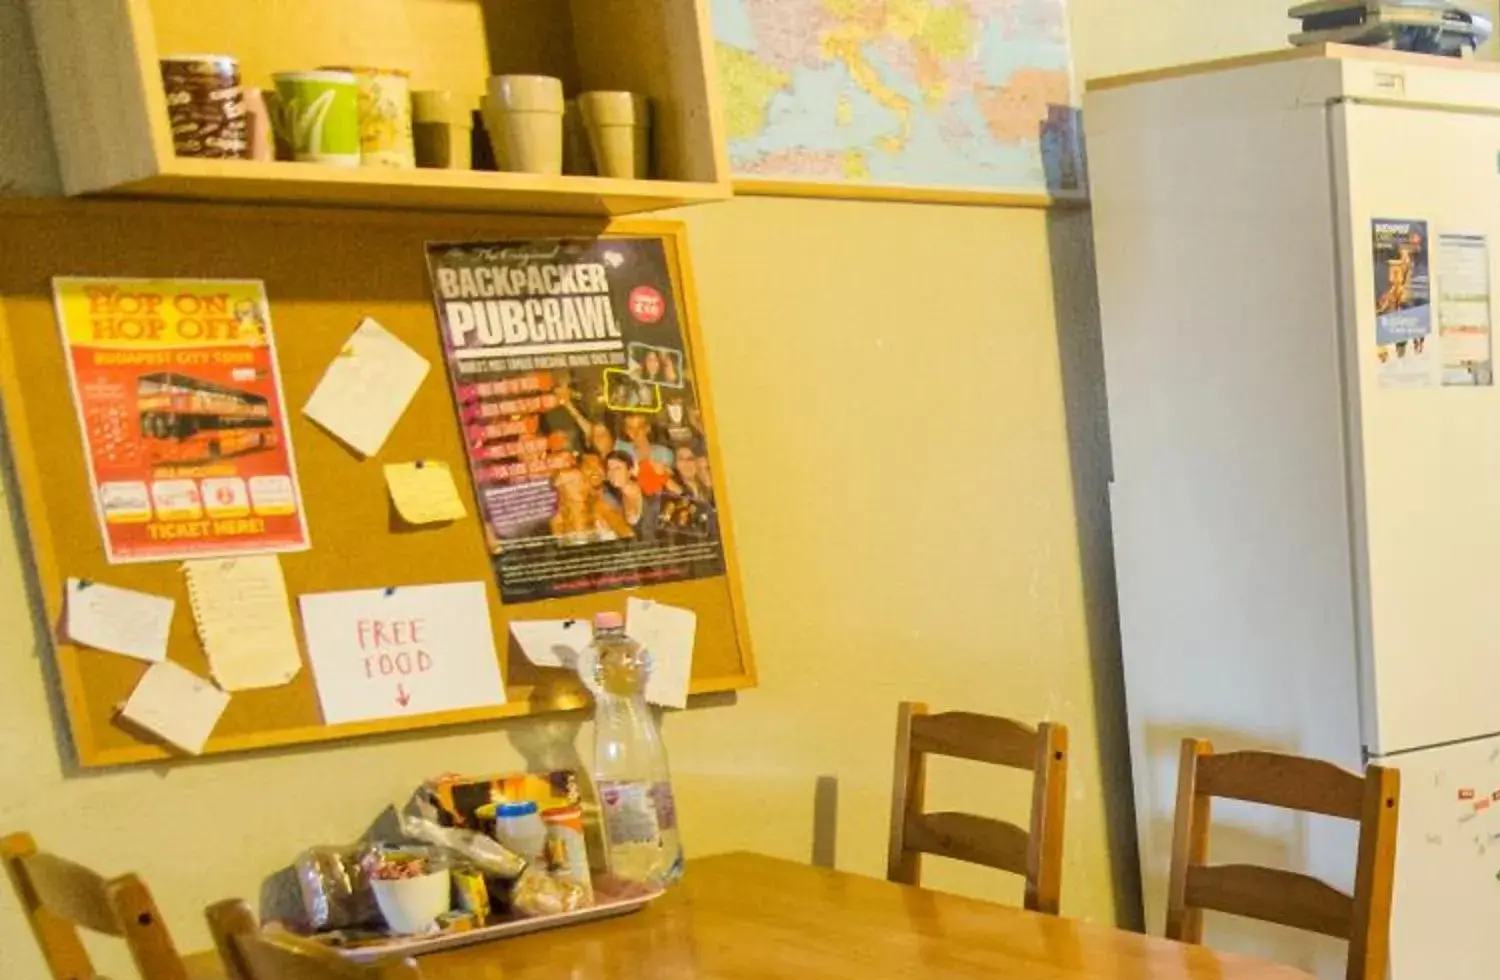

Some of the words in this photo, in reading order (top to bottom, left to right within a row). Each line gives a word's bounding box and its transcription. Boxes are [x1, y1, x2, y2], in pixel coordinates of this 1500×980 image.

[437, 263, 609, 299] BACKPACKER
[89, 292, 162, 315] HOP
[175, 292, 231, 315] ON
[92, 317, 165, 340] HOP
[446, 296, 622, 347] PUBCRAWL
[147, 520, 211, 540] TICKET
[357, 618, 426, 649] FREE
[361, 650, 434, 679] FOOD
